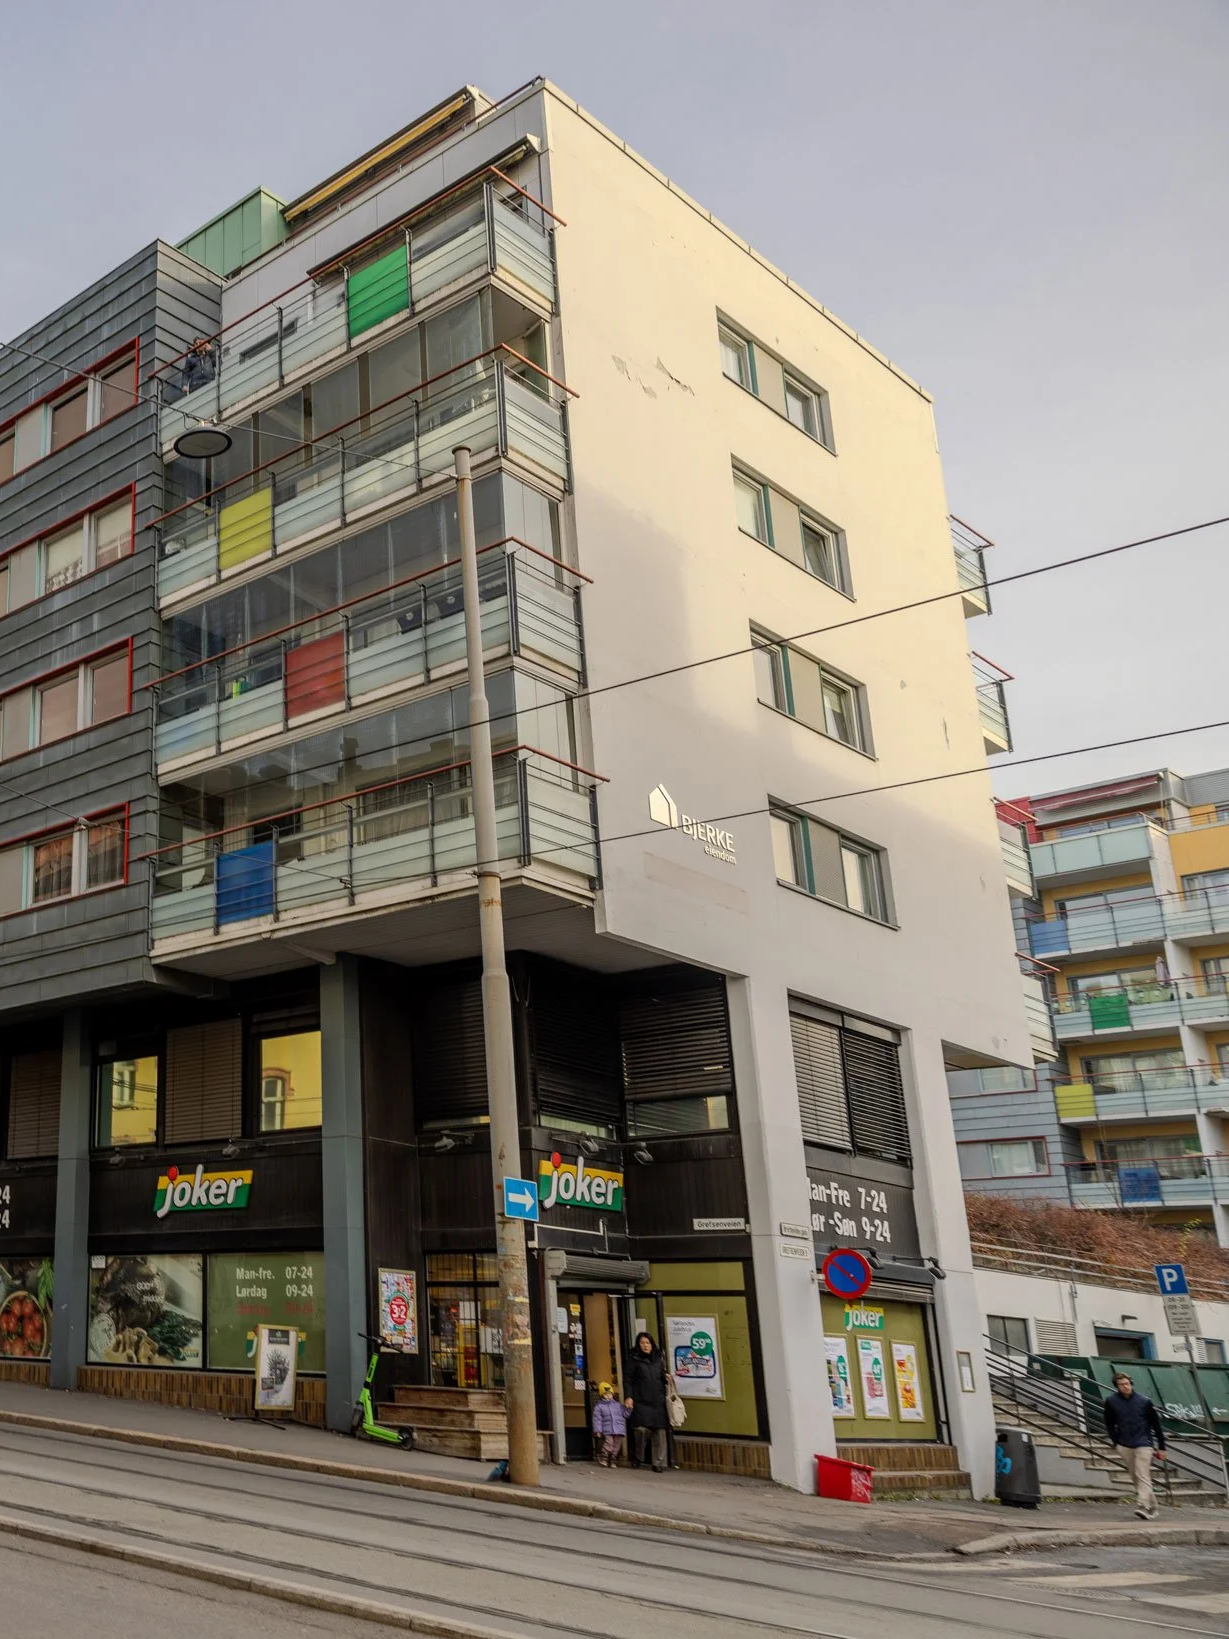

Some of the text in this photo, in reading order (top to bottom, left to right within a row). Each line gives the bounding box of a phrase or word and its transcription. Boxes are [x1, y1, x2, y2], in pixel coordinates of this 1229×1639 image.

[681, 814, 736, 853] BJERKE
[703, 845, 737, 865] eiendom
[156, 1164, 243, 1219] joker
[543, 1152, 619, 1209] joker
[809, 1181, 888, 1213] an-Fre 7-24
[811, 1213, 825, 1232] ør
[861, 1216, 891, 1243] 9-24
[285, 1266, 313, 1279] 07-24
[1161, 1268, 1179, 1291] P
[236, 1284, 313, 1299] Lørdag 09-24
[846, 1300, 882, 1332] joker
